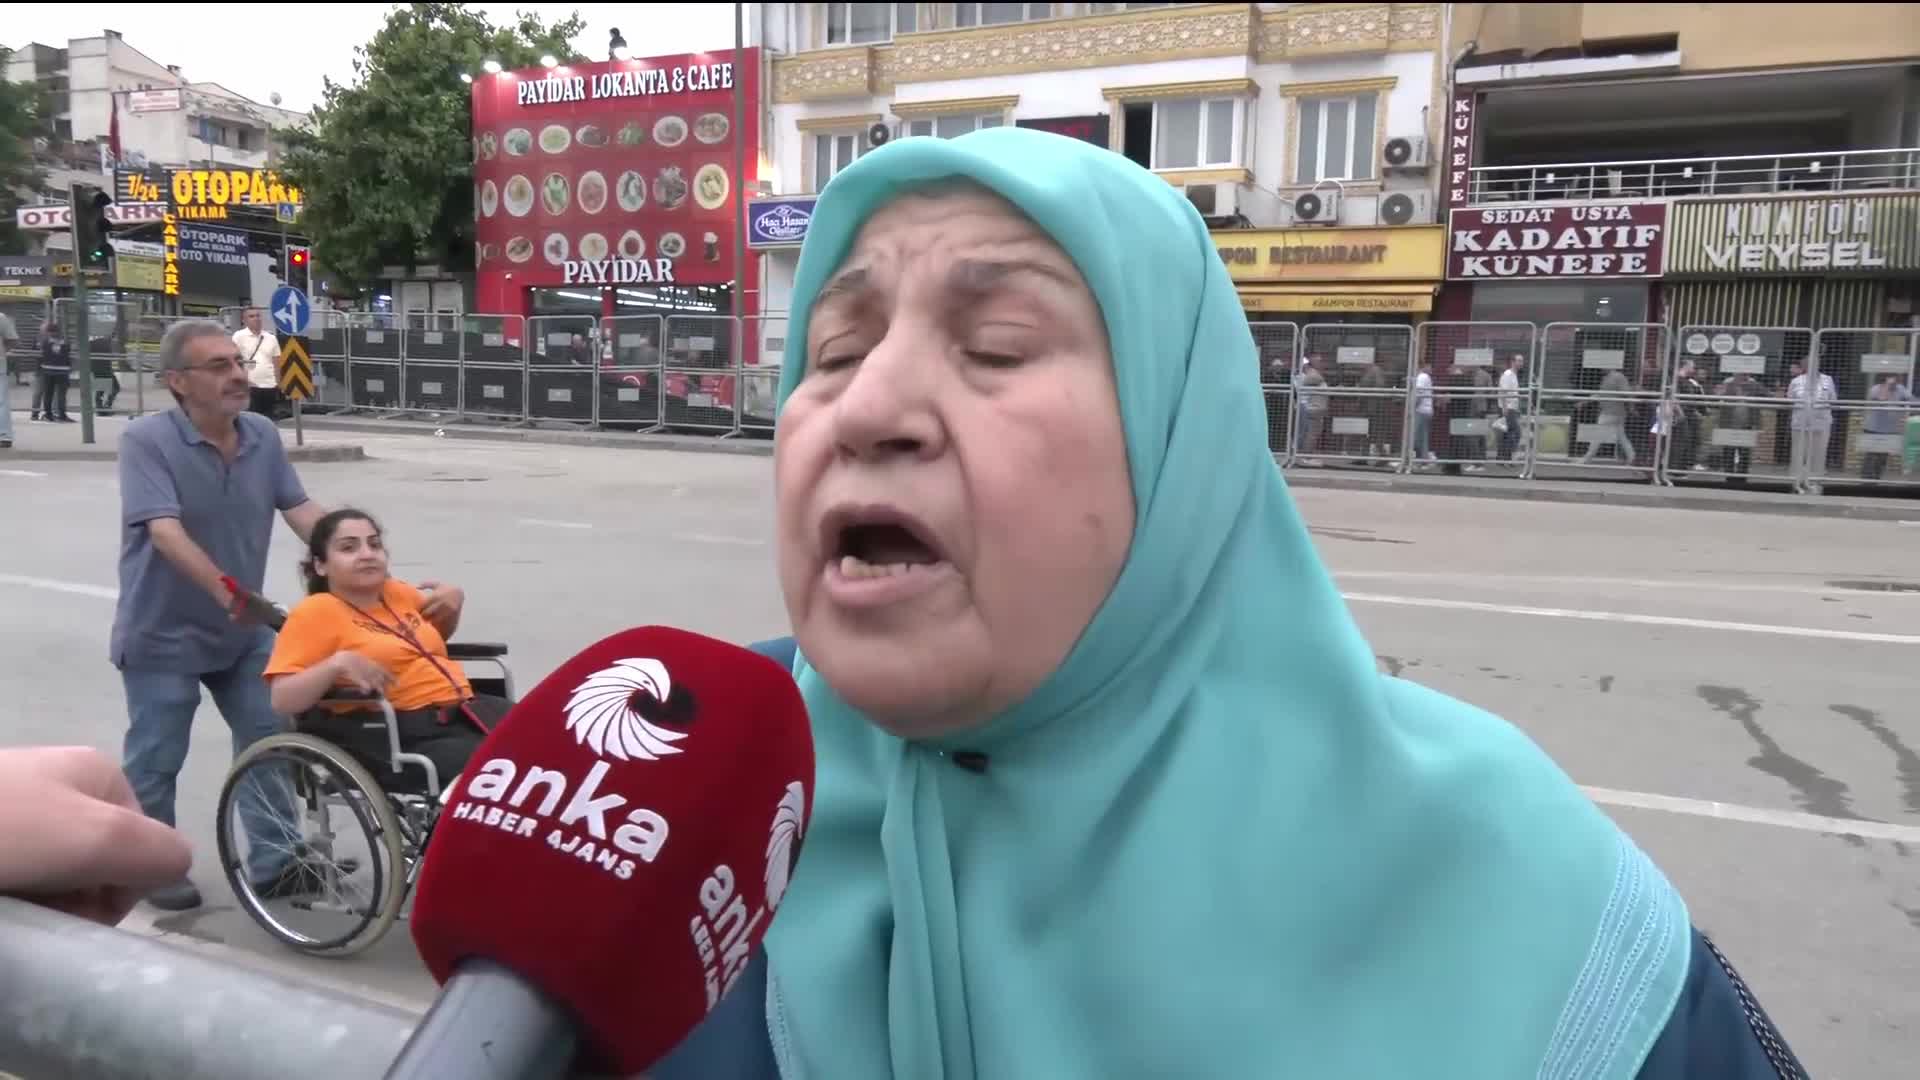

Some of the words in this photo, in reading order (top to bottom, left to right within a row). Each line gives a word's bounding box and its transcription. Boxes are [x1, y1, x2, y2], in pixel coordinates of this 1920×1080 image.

[592, 69, 669, 98] LOKANTA
[672, 67, 685, 92] &
[687, 63, 733, 90] CAFE
[1451, 100, 1470, 201] KÜNEFE
[127, 173, 159, 201] 7/24
[1481, 209, 1554, 224] SEDAT
[1571, 206, 1632, 221] USTA
[181, 229, 246, 247] OTOPARK
[1453, 225, 1660, 251] KADAYIF
[181, 249, 203, 262] OTO
[563, 254, 674, 284] PAYİDAR
[1269, 245, 1387, 265] RESTAURANT
[1461, 253, 1647, 276] KÜNEFE
[1703, 241, 1886, 269] VEYSEL
[453, 801, 539, 838] HABER
[467, 758, 670, 863] anka
